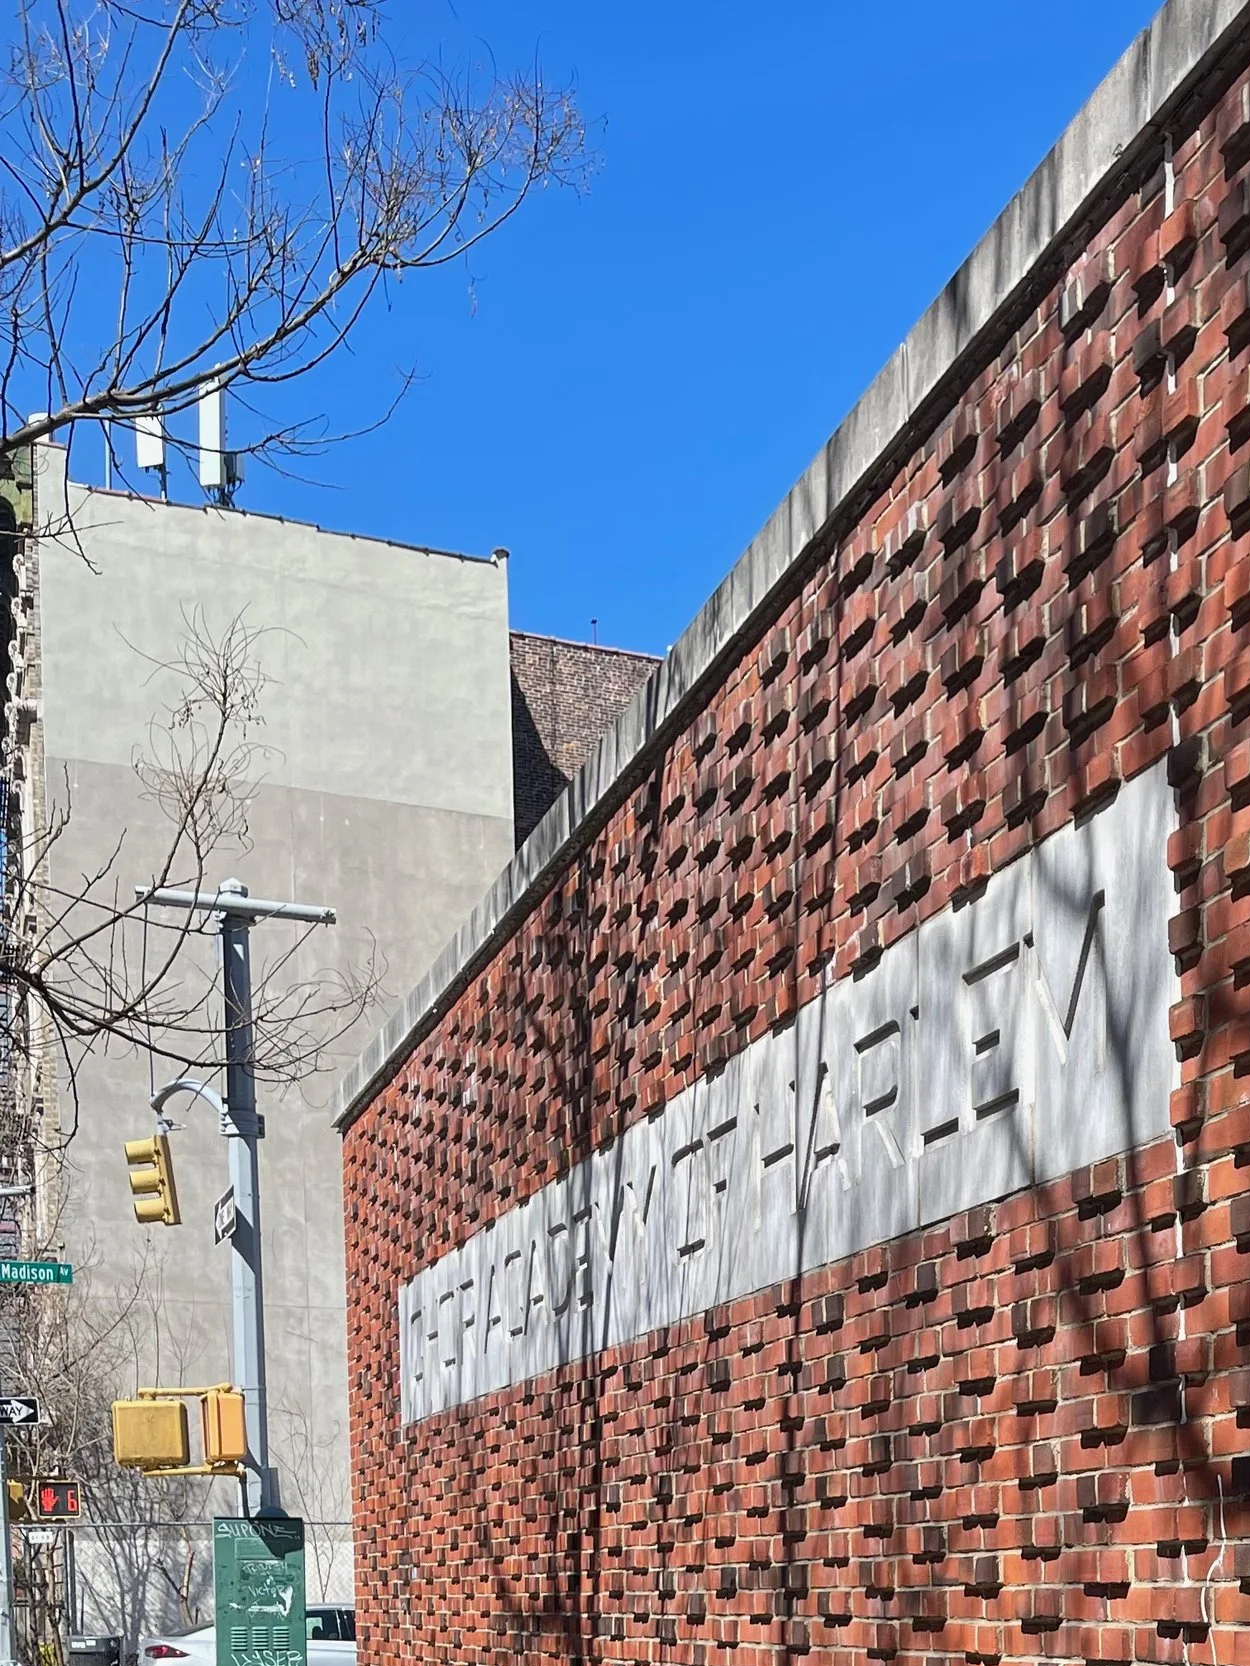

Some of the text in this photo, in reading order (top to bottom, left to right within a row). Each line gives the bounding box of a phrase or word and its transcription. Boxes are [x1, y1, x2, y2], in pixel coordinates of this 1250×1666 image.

[483, 1164, 657, 1355] ACADEMY
[671, 1116, 738, 1266] OF
[752, 888, 1105, 1232] HARLEM
[1, 1263, 54, 1280] Madison
[0, 1406, 23, 1416] WAY
[67, 1490, 78, 1511] 6
